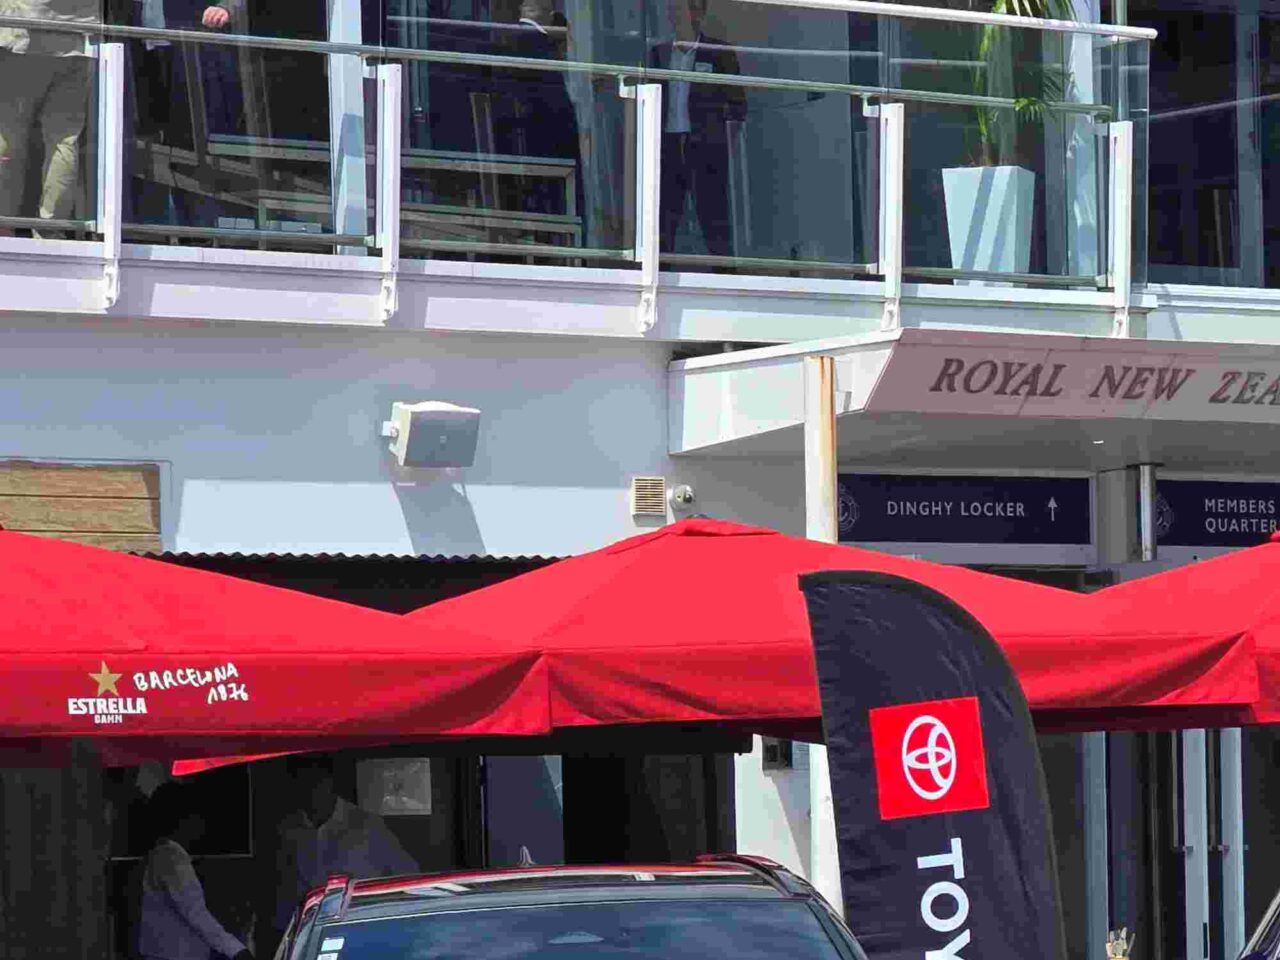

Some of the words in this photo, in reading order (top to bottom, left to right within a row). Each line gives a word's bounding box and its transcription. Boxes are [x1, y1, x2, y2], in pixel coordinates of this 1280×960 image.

[929, 357, 1066, 398] ROYAL
[1089, 365, 1196, 401] NEW
[887, 501, 953, 516] DINGHY
[960, 502, 1025, 517] LOCKER
[1205, 498, 1276, 514] MEMBERS
[133, 662, 239, 692] BARCELONA
[207, 682, 249, 704] 1876
[67, 697, 147, 715] ESTRELLA
